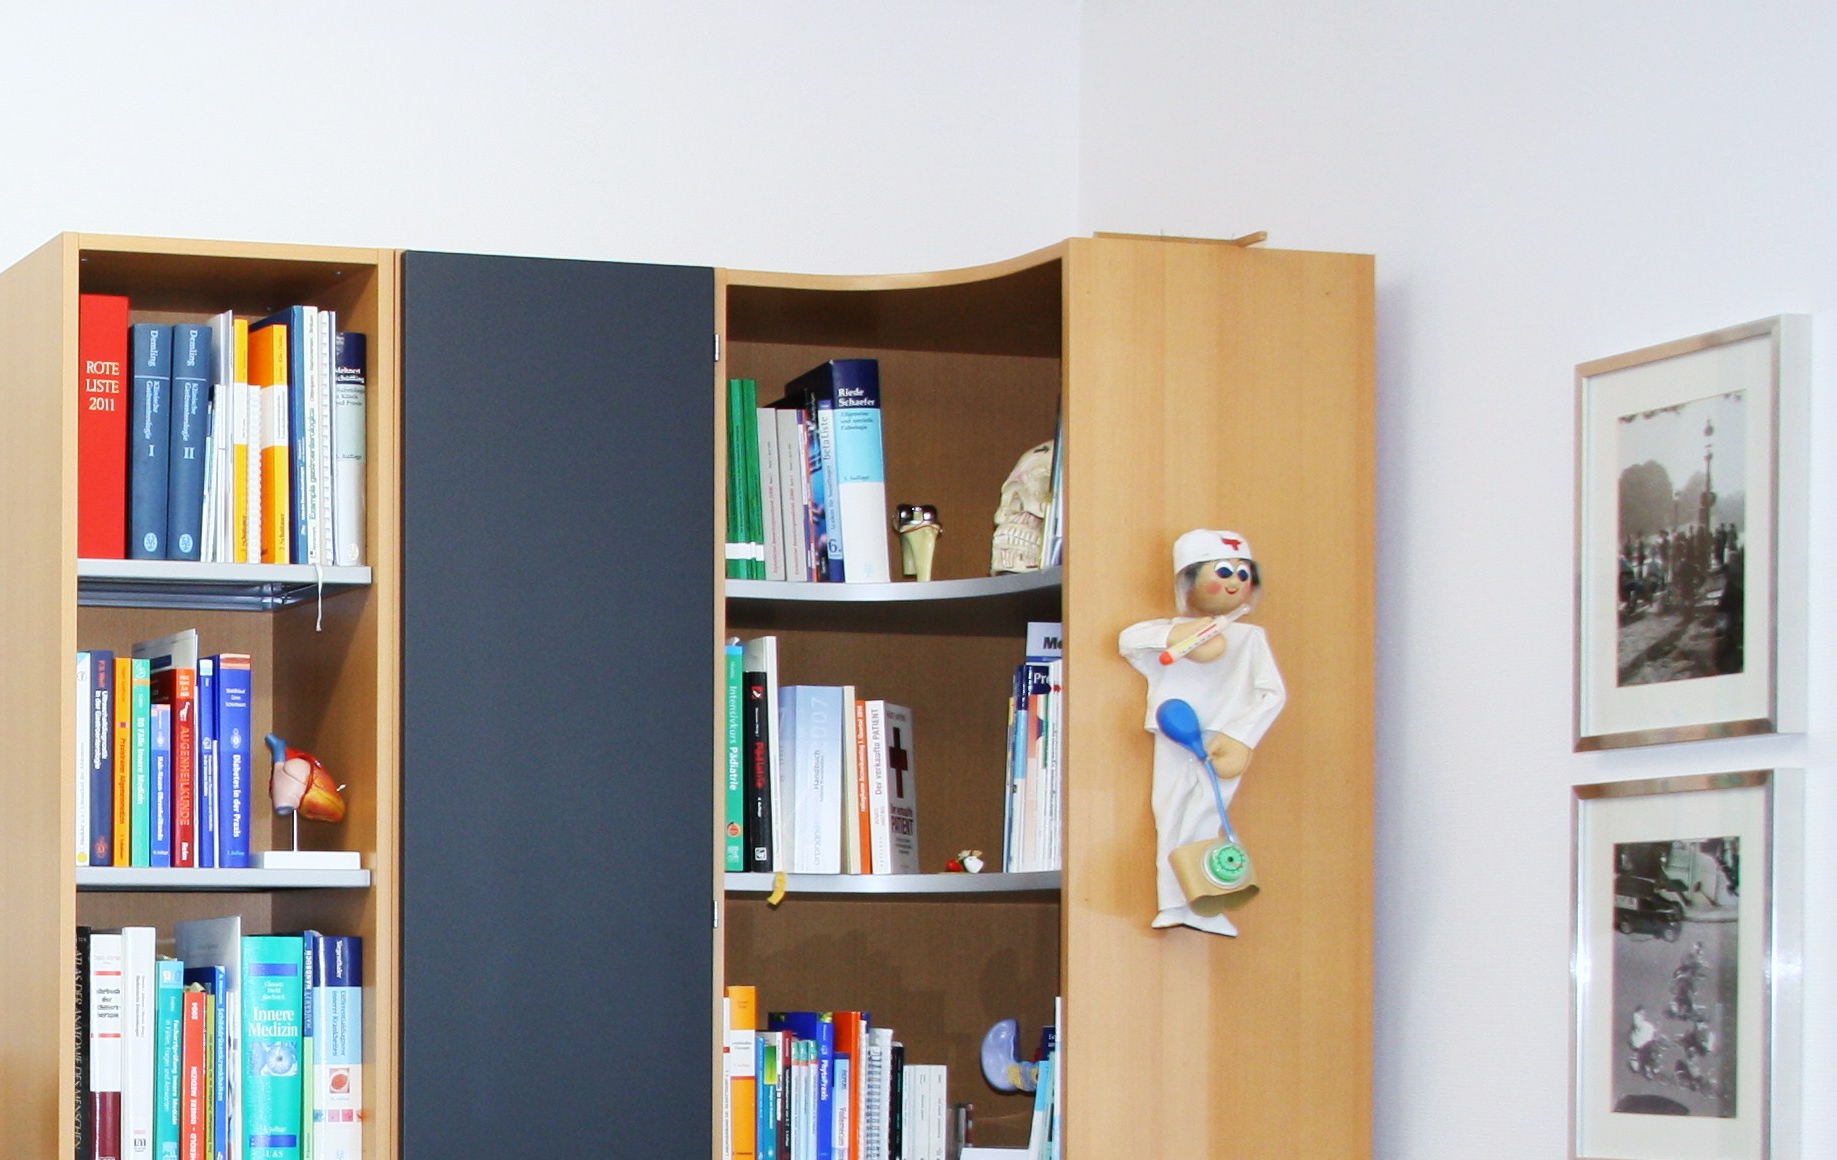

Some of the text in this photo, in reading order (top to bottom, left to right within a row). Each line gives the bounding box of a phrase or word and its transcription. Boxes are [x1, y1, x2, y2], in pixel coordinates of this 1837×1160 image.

[147, 330, 159, 368] Demling
[186, 329, 198, 367] Demling
[86, 360, 120, 376] ROTE
[86, 379, 120, 394] LISTE
[152, 381, 161, 414] Klinische
[190, 382, 199, 415] Klinische
[838, 388, 864, 397] Riede
[838, 397, 876, 408] Schaefer
[88, 397, 115, 412] 2011
[148, 444, 155, 457] I
[183, 446, 195, 460] II
[728, 685, 739, 791] Intensivkurs Pädiatrie
[870, 708, 883, 796] Der verkaufte PATIENT
[179, 725, 190, 826] AUGENHEILKUNDE
[812, 750, 821, 790] Handbuch
[231, 754, 242, 838] Diabetes in der Praxis
[248, 1021, 299, 1037] Medizin
[252, 1006, 295, 1022] Innere
[190, 1066, 198, 1098] MEDIZIN
[819, 1059, 830, 1101] PhytoPraxis
[171, 1098, 180, 1126] Medizin
